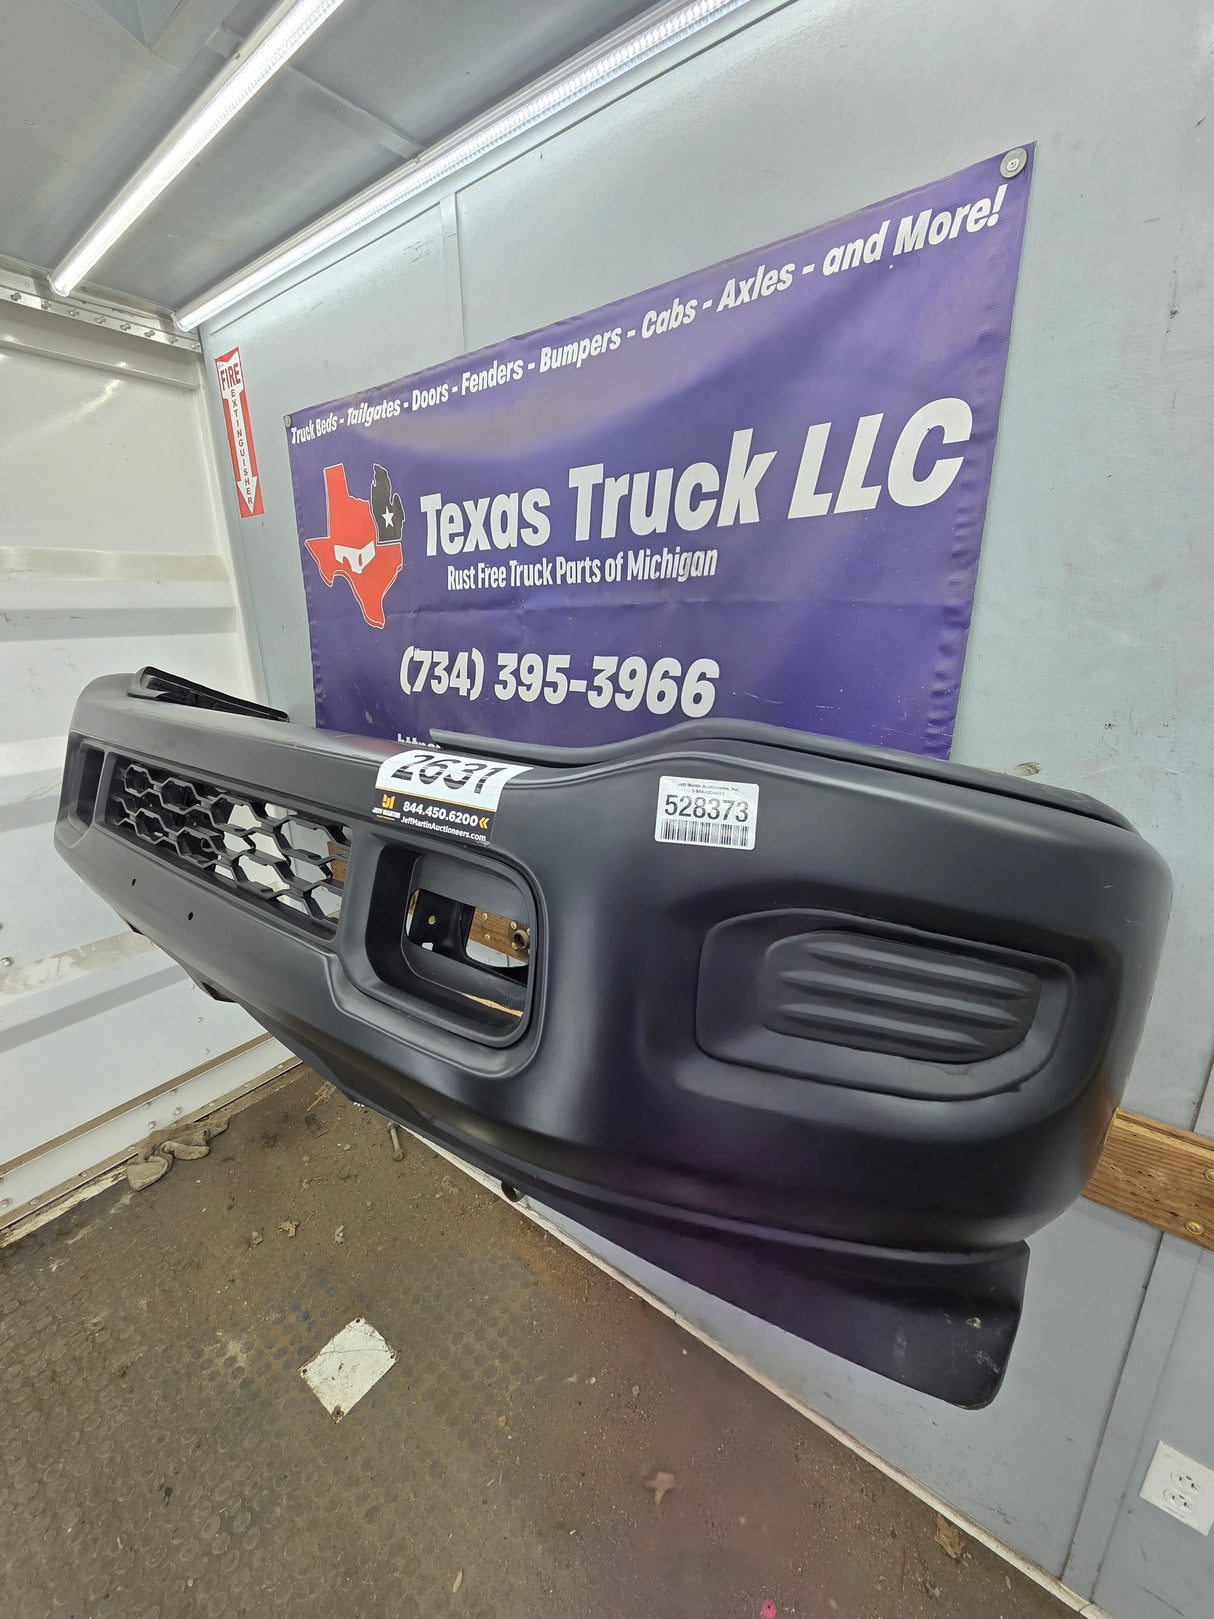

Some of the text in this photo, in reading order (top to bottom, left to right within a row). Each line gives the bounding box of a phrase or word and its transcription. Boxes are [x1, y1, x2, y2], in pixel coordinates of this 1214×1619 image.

[291, 420, 315, 444] Truck
[316, 413, 338, 437] Beds
[347, 398, 401, 427] Tailgates
[412, 383, 449, 411] Doors
[461, 360, 524, 395] Fenders
[539, 327, 622, 368] Bumpers
[641, 298, 698, 339] Cabs
[716, 264, 796, 312] Axles
[822, 220, 891, 276] and
[893, 184, 1008, 257] More!
[220, 362, 241, 391] FIRE
[230, 389, 253, 504] EXTINGUISHER
[420, 397, 973, 557] Texas Truck LLC
[447, 546, 718, 590] Rust Free Truck Parts of Michigan
[400, 646, 720, 718] (734) 395-3966
[391, 754, 508, 795] 2631
[401, 816, 487, 842] JeffMartinAuctioneers.com
[403, 800, 479, 827] 844.450.6200
[665, 794, 749, 823] 528373
